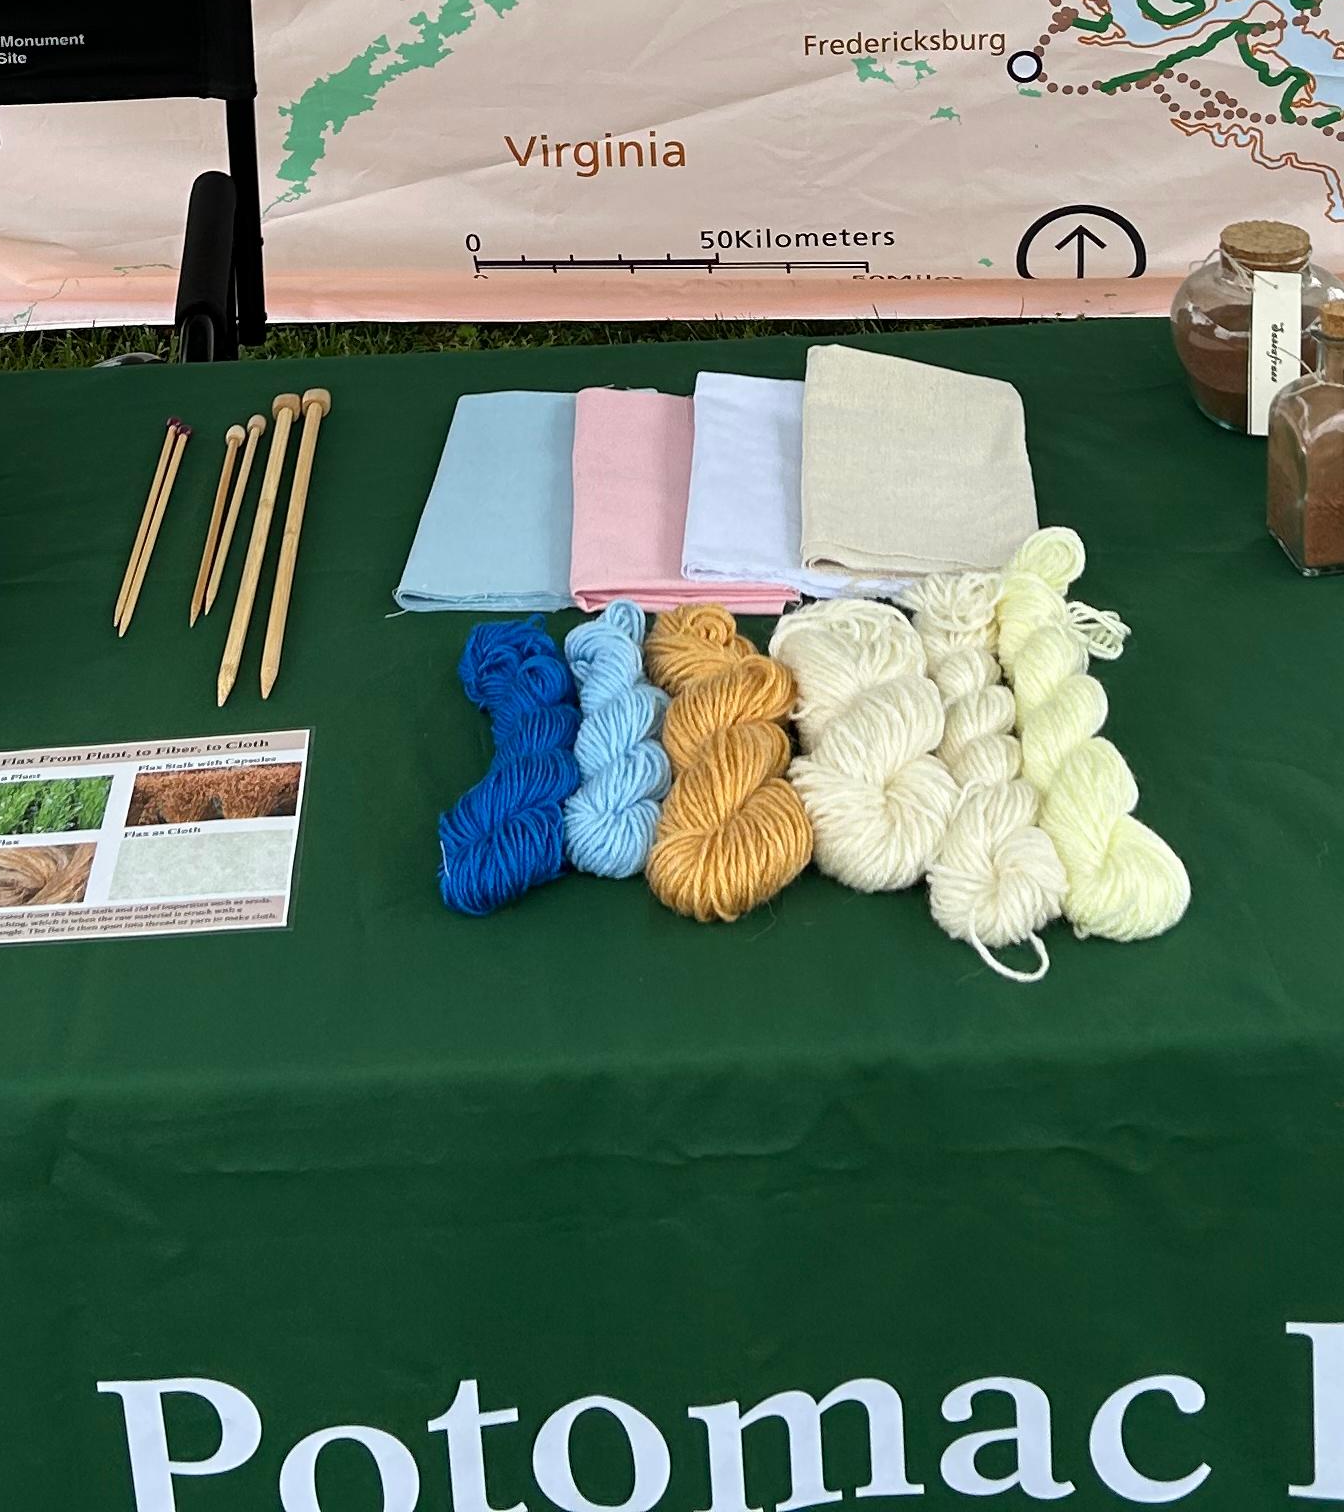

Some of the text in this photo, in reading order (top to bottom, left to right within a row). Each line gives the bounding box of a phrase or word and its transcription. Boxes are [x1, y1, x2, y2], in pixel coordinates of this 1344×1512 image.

[0, 33, 85, 48] Monument
[804, 29, 1006, 56] Fredericksburg
[504, 131, 685, 177] Virginia
[466, 234, 480, 252] 0
[1266, 322, 1285, 383] Sassafras
[1, 739, 269, 766] Flax From Plant, to Fiber, to Cloth
[138, 756, 277, 772] Flax Stalk with Capsules
[10, 773, 41, 781] Plant
[123, 830, 149, 839] Flax
[167, 826, 201, 835] Cloth
[96, 1371, 1208, 1512] Potomac
